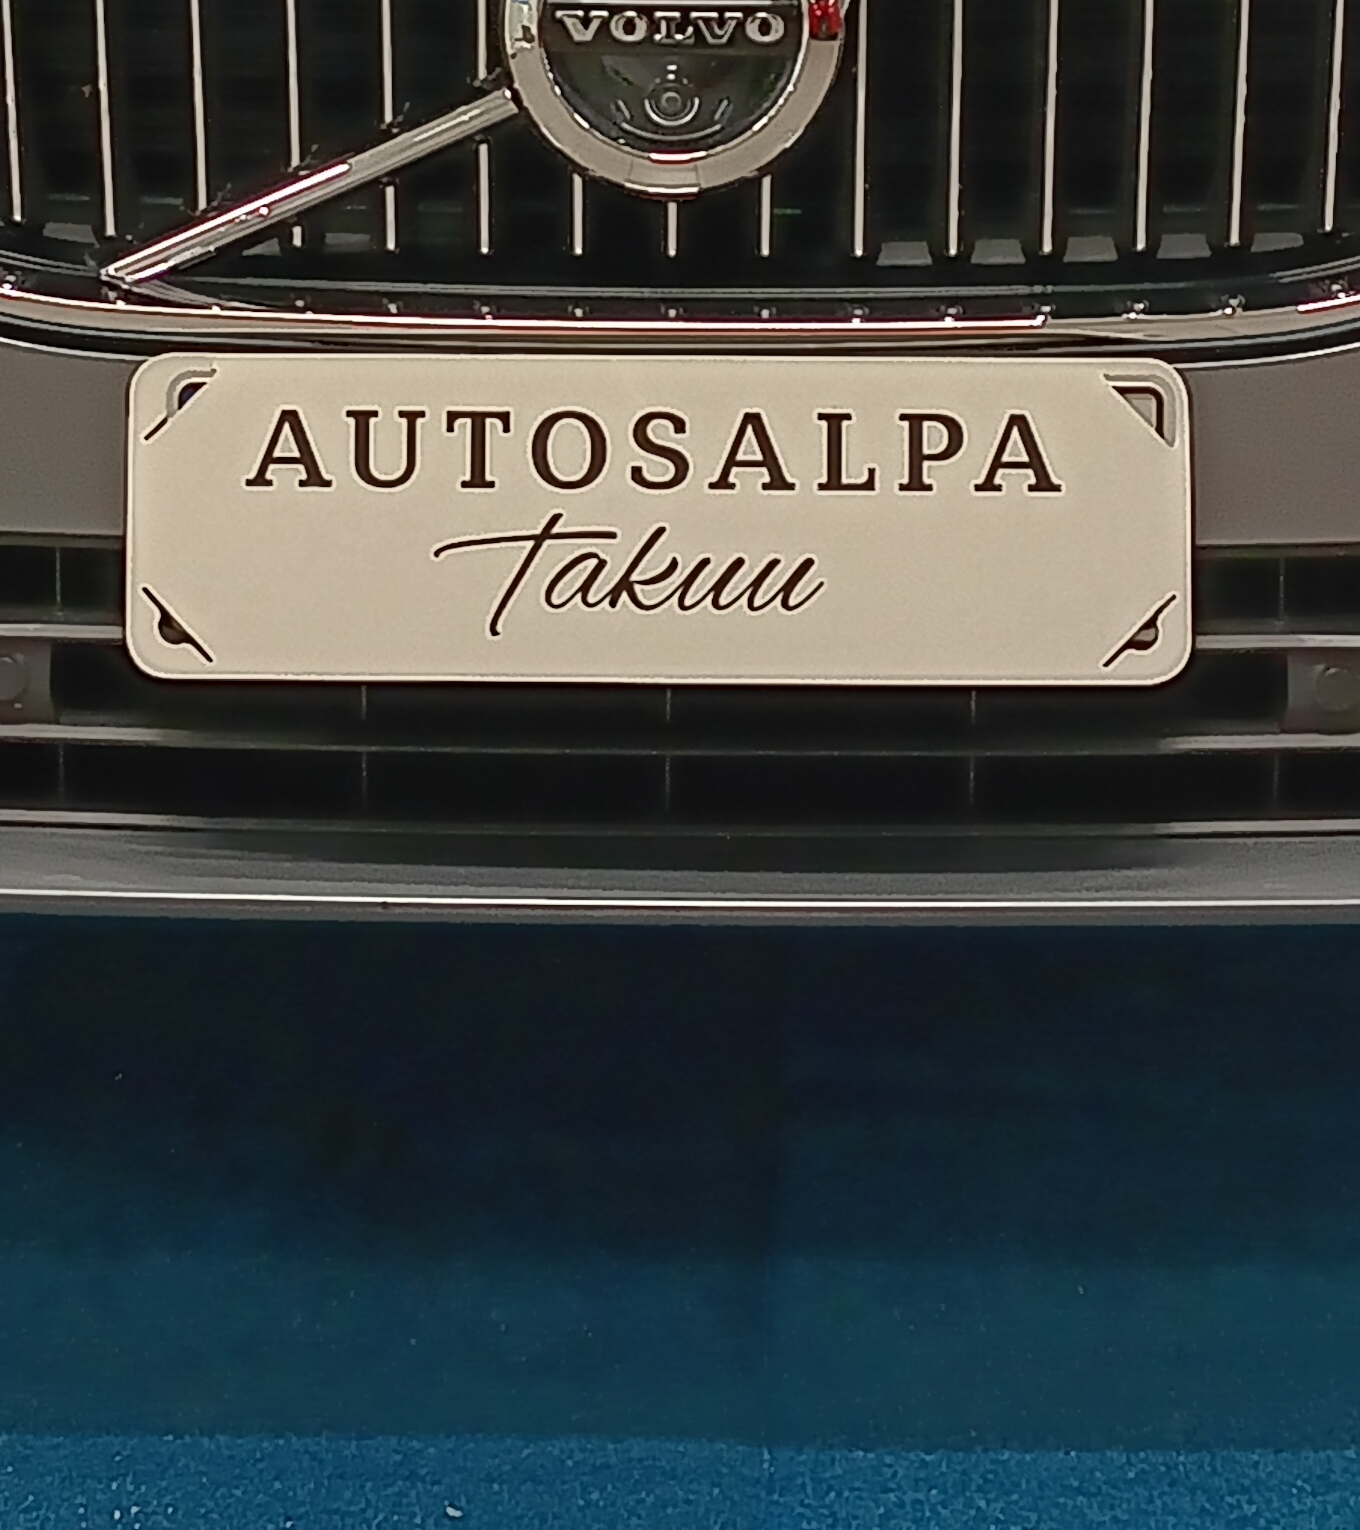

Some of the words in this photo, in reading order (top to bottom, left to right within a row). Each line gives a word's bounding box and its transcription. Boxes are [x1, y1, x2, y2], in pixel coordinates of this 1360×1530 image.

[554, 9, 786, 46] VOLVO
[245, 409, 1062, 493] AUTOSALPA
[433, 512, 825, 637] Takuu
